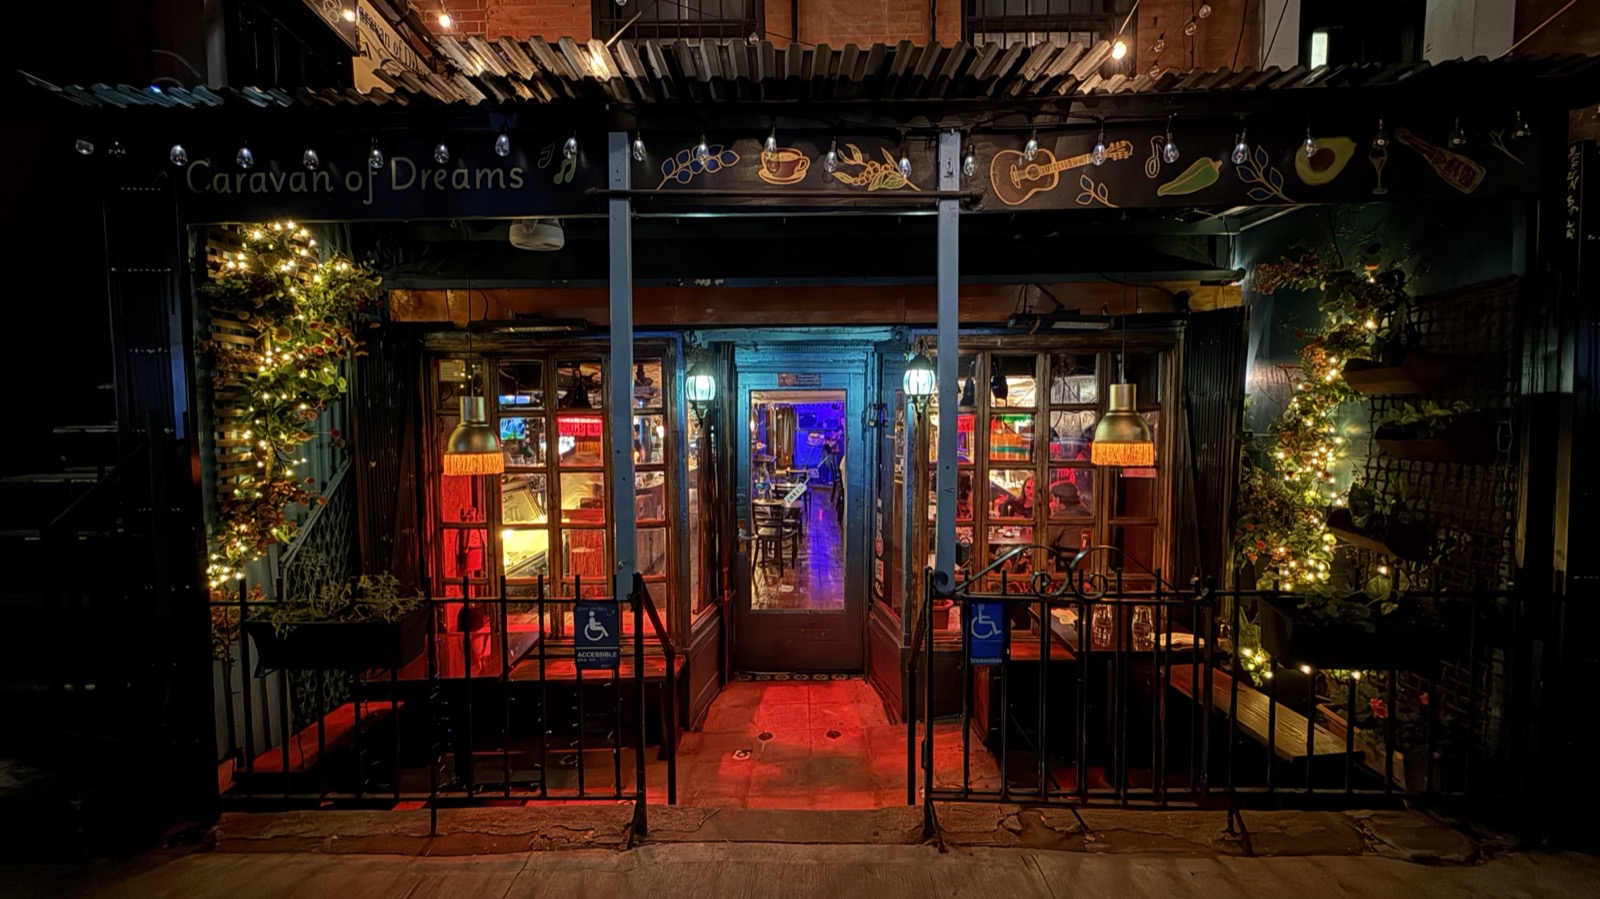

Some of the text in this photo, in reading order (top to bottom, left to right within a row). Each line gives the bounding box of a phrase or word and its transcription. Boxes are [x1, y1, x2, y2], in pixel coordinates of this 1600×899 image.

[186, 156, 524, 205] Caravan of Dreams
